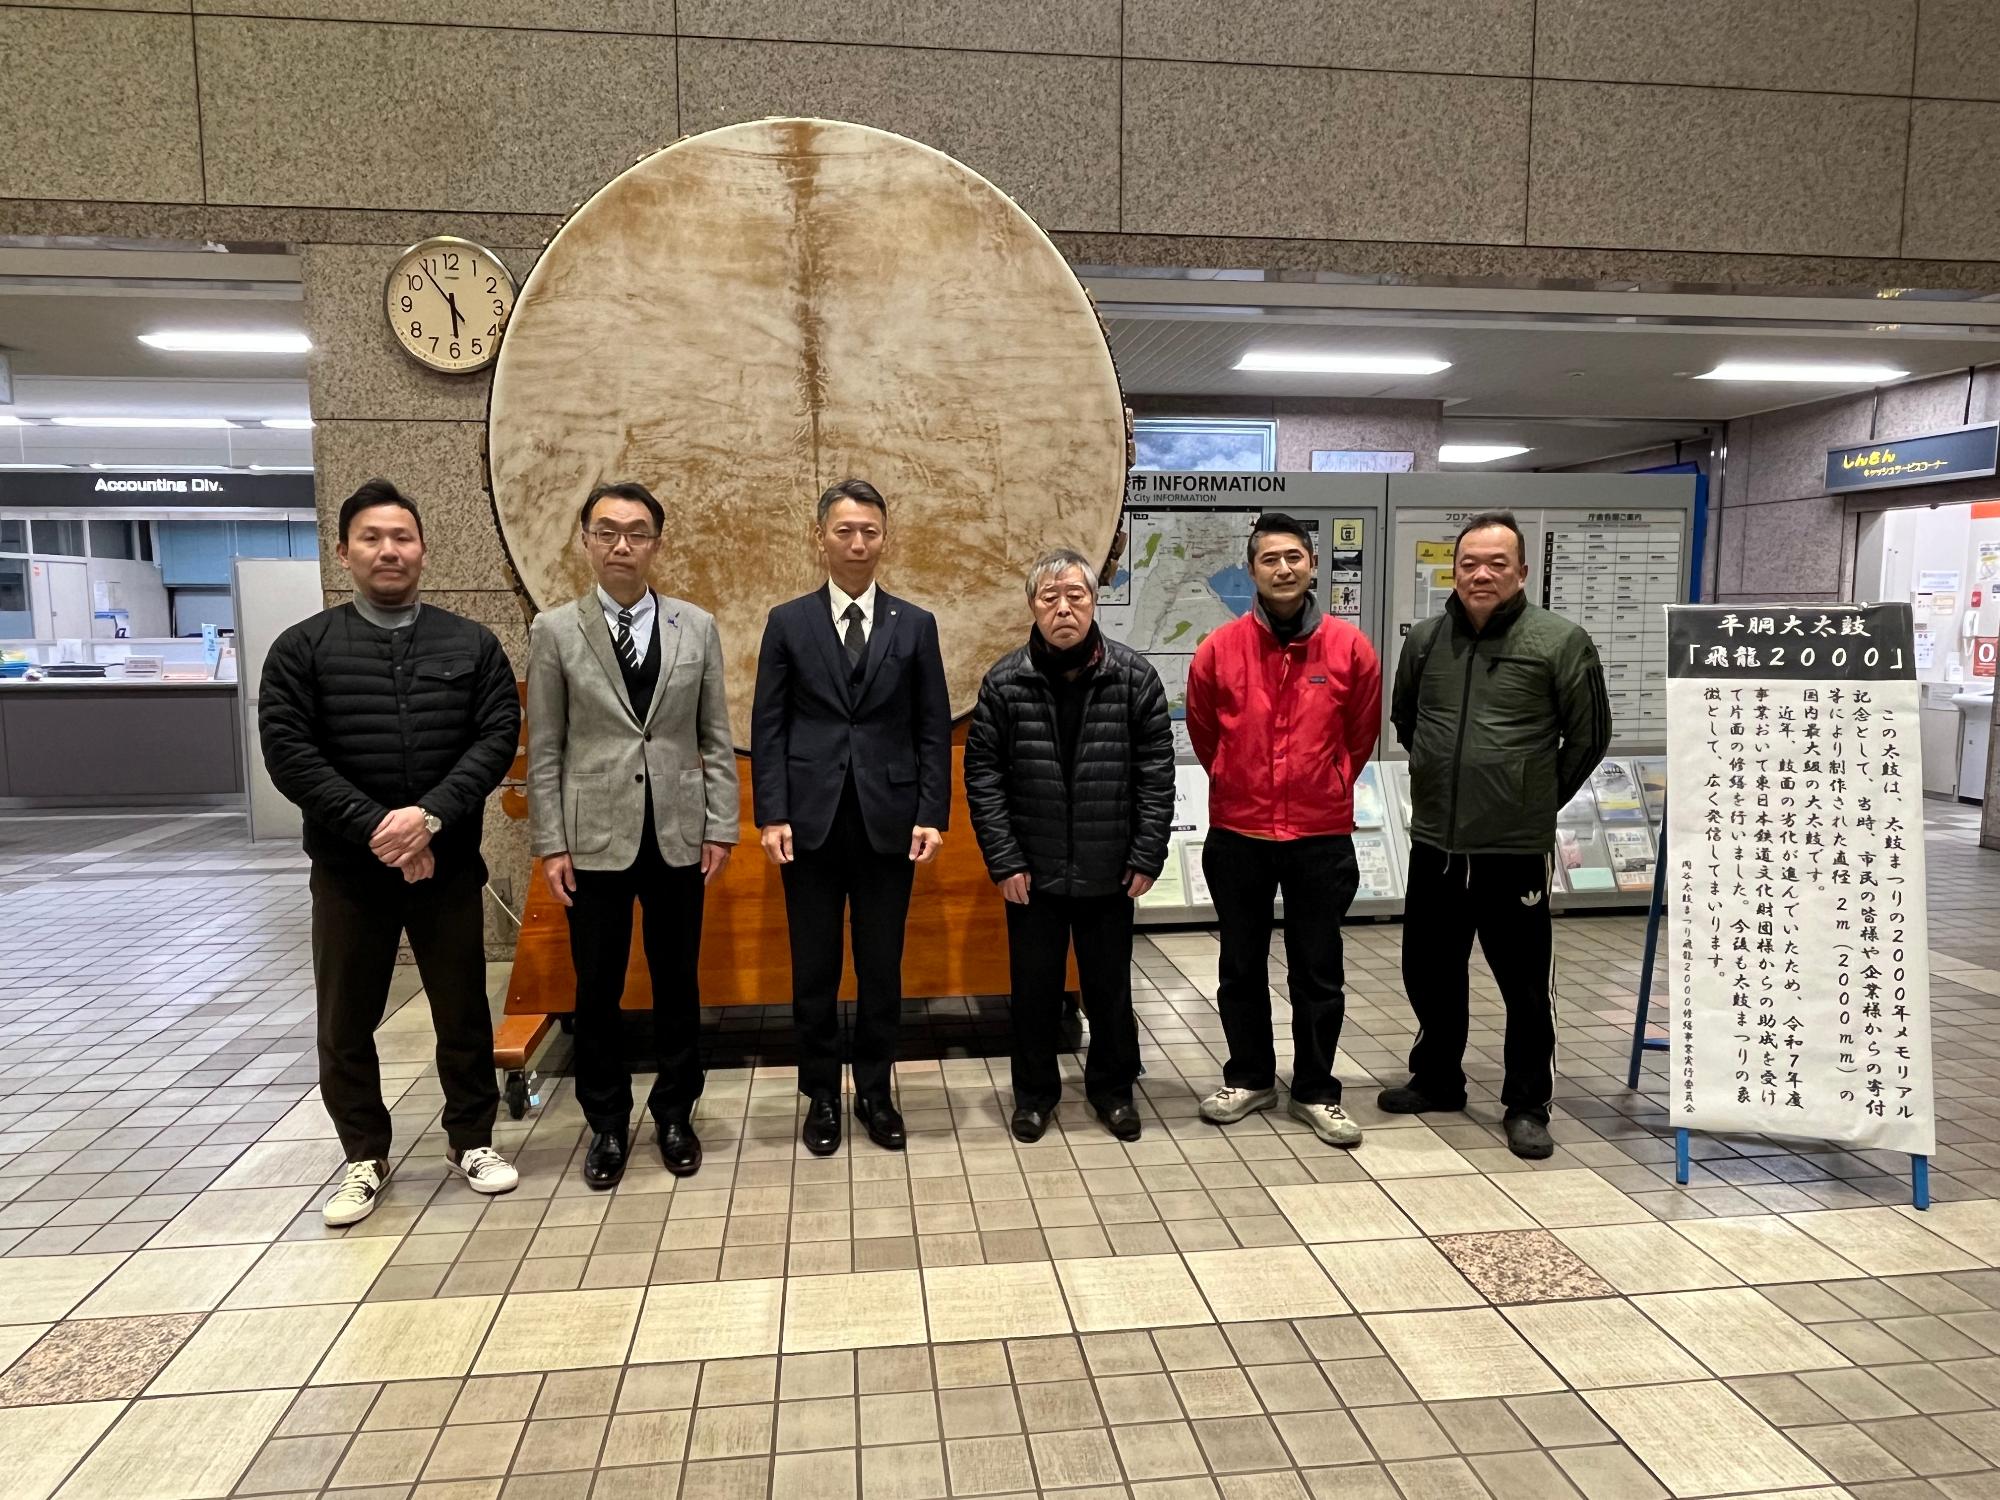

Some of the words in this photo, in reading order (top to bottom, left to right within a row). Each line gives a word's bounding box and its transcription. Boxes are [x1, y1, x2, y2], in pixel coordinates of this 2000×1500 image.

[424, 258, 437, 276] 11
[443, 253, 459, 270] 12
[472, 259, 477, 277] 1
[407, 274, 423, 291] 10
[486, 276, 497, 294] 2
[401, 295, 413, 313] 9
[493, 299, 504, 316] 3
[410, 321, 422, 338] 8
[487, 323, 498, 337] 4
[429, 336, 439, 353] 7
[449, 342, 461, 359] 6
[471, 338, 483, 355] 5
[1842, 448, 1896, 469] しんきん
[94, 478, 188, 493] Accounting
[191, 478, 224, 492] Div.
[1128, 474, 1148, 492] 市
[1153, 475, 1286, 492] INFORMATION
[1134, 493, 1151, 504] City
[1153, 494, 1217, 503] INFORMATION
[1717, 613, 1872, 638] 平胴大太鼓
[1689, 644, 1902, 669] 「飛龍2000」
[1802, 689, 1825, 891] 国内最大級の大太鼓です。
